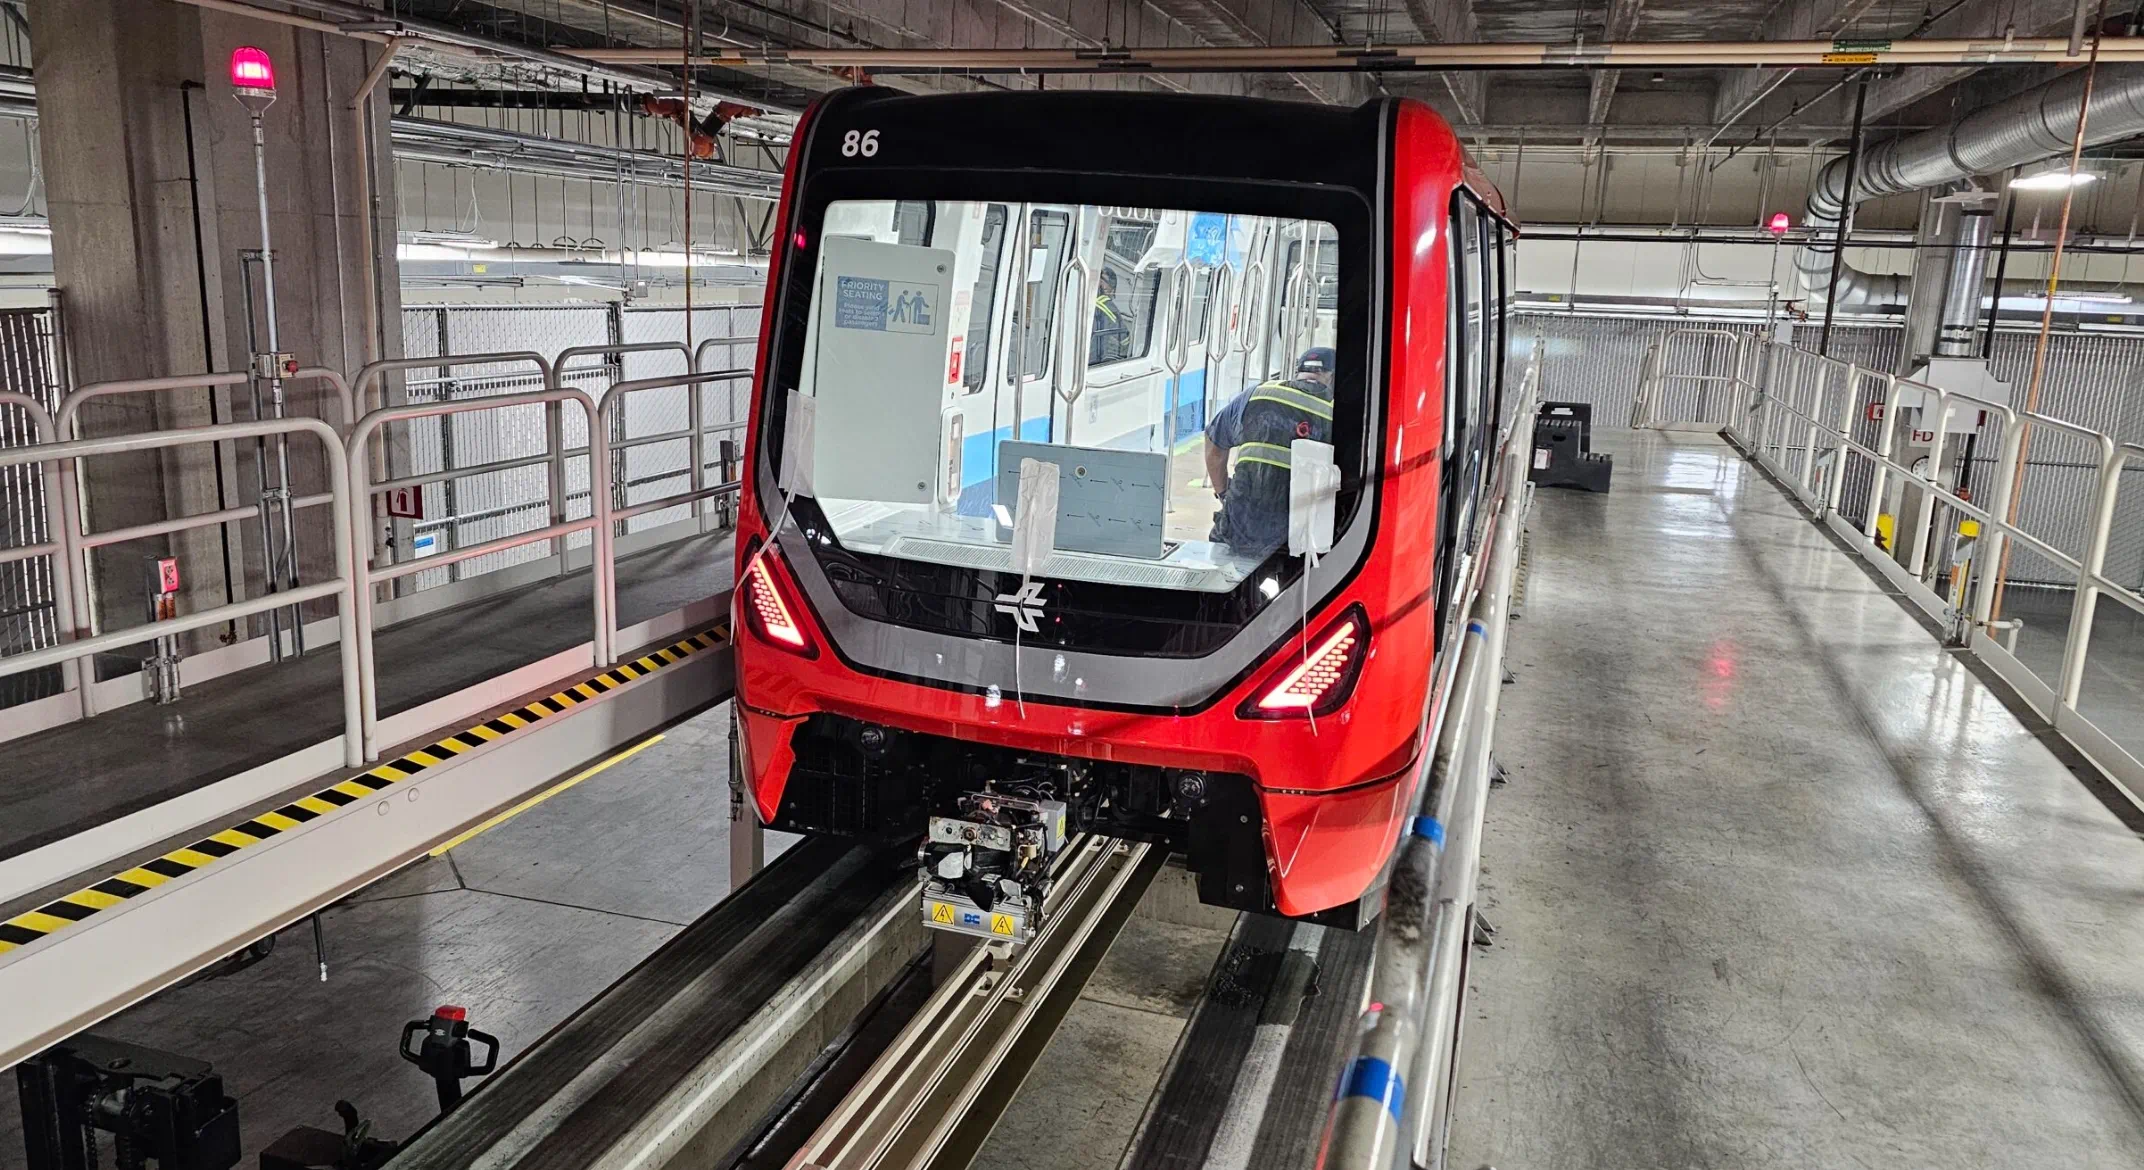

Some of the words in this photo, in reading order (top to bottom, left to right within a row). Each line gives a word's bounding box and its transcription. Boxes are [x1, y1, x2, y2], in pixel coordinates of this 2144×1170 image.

[842, 130, 880, 157] 86
[841, 280, 884, 291] PRIORITY
[843, 289, 883, 300] SEATING
[1912, 429, 1936, 442] FD
